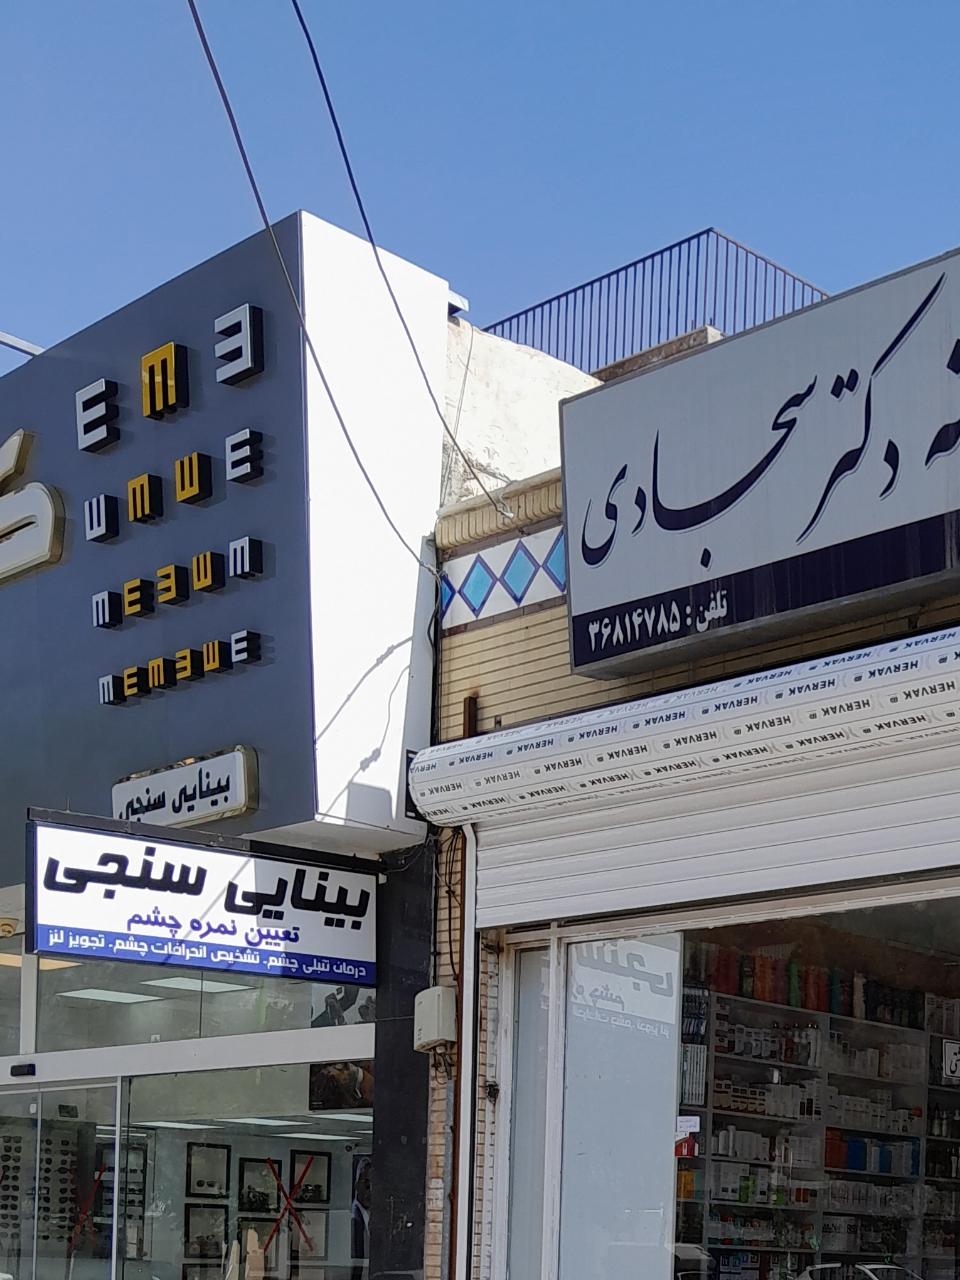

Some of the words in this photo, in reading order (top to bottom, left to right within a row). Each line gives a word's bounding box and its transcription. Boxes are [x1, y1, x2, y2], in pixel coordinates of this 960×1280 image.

[796, 271, 947, 542] دکتر
[517, 738, 554, 753] HERVAK
[578, 725, 618, 739] HERVAK
[644, 710, 686, 727] HERVAK
[713, 695, 758, 713] HERVAK
[788, 678, 836, 697] HERVAK
[868, 659, 919, 680] HERVAK
[428, 782, 463, 795] HERVAK
[484, 770, 521, 785] HERVAK
[544, 757, 582, 772] HERVAK
[606, 744, 648, 760] HERVAK
[673, 730, 718, 747] HERVAK
[745, 715, 792, 733] HERVAK
[821, 698, 871, 717] HERVAK
[903, 681, 956, 700] HERVAK
[653, 759, 697, 775] HERVAK
[722, 745, 769, 761] HERVAK
[796, 730, 846, 747] HERVAK
[874, 714, 927, 732] HERVAK
[172, 767, 230, 813] بینایی
[43, 847, 207, 900] سنجی
[224, 869, 371, 930] بینایی
[127, 907, 182, 937] چشم
[190, 917, 237, 939] نمره
[245, 926, 300, 947] تعیین
[49, 929, 64, 946] لنز
[69, 932, 105, 949] تجویز
[151, 940, 207, 961] انحرافات
[211, 948, 260, 965] تشخیص
[333, 963, 366, 979] درمان
